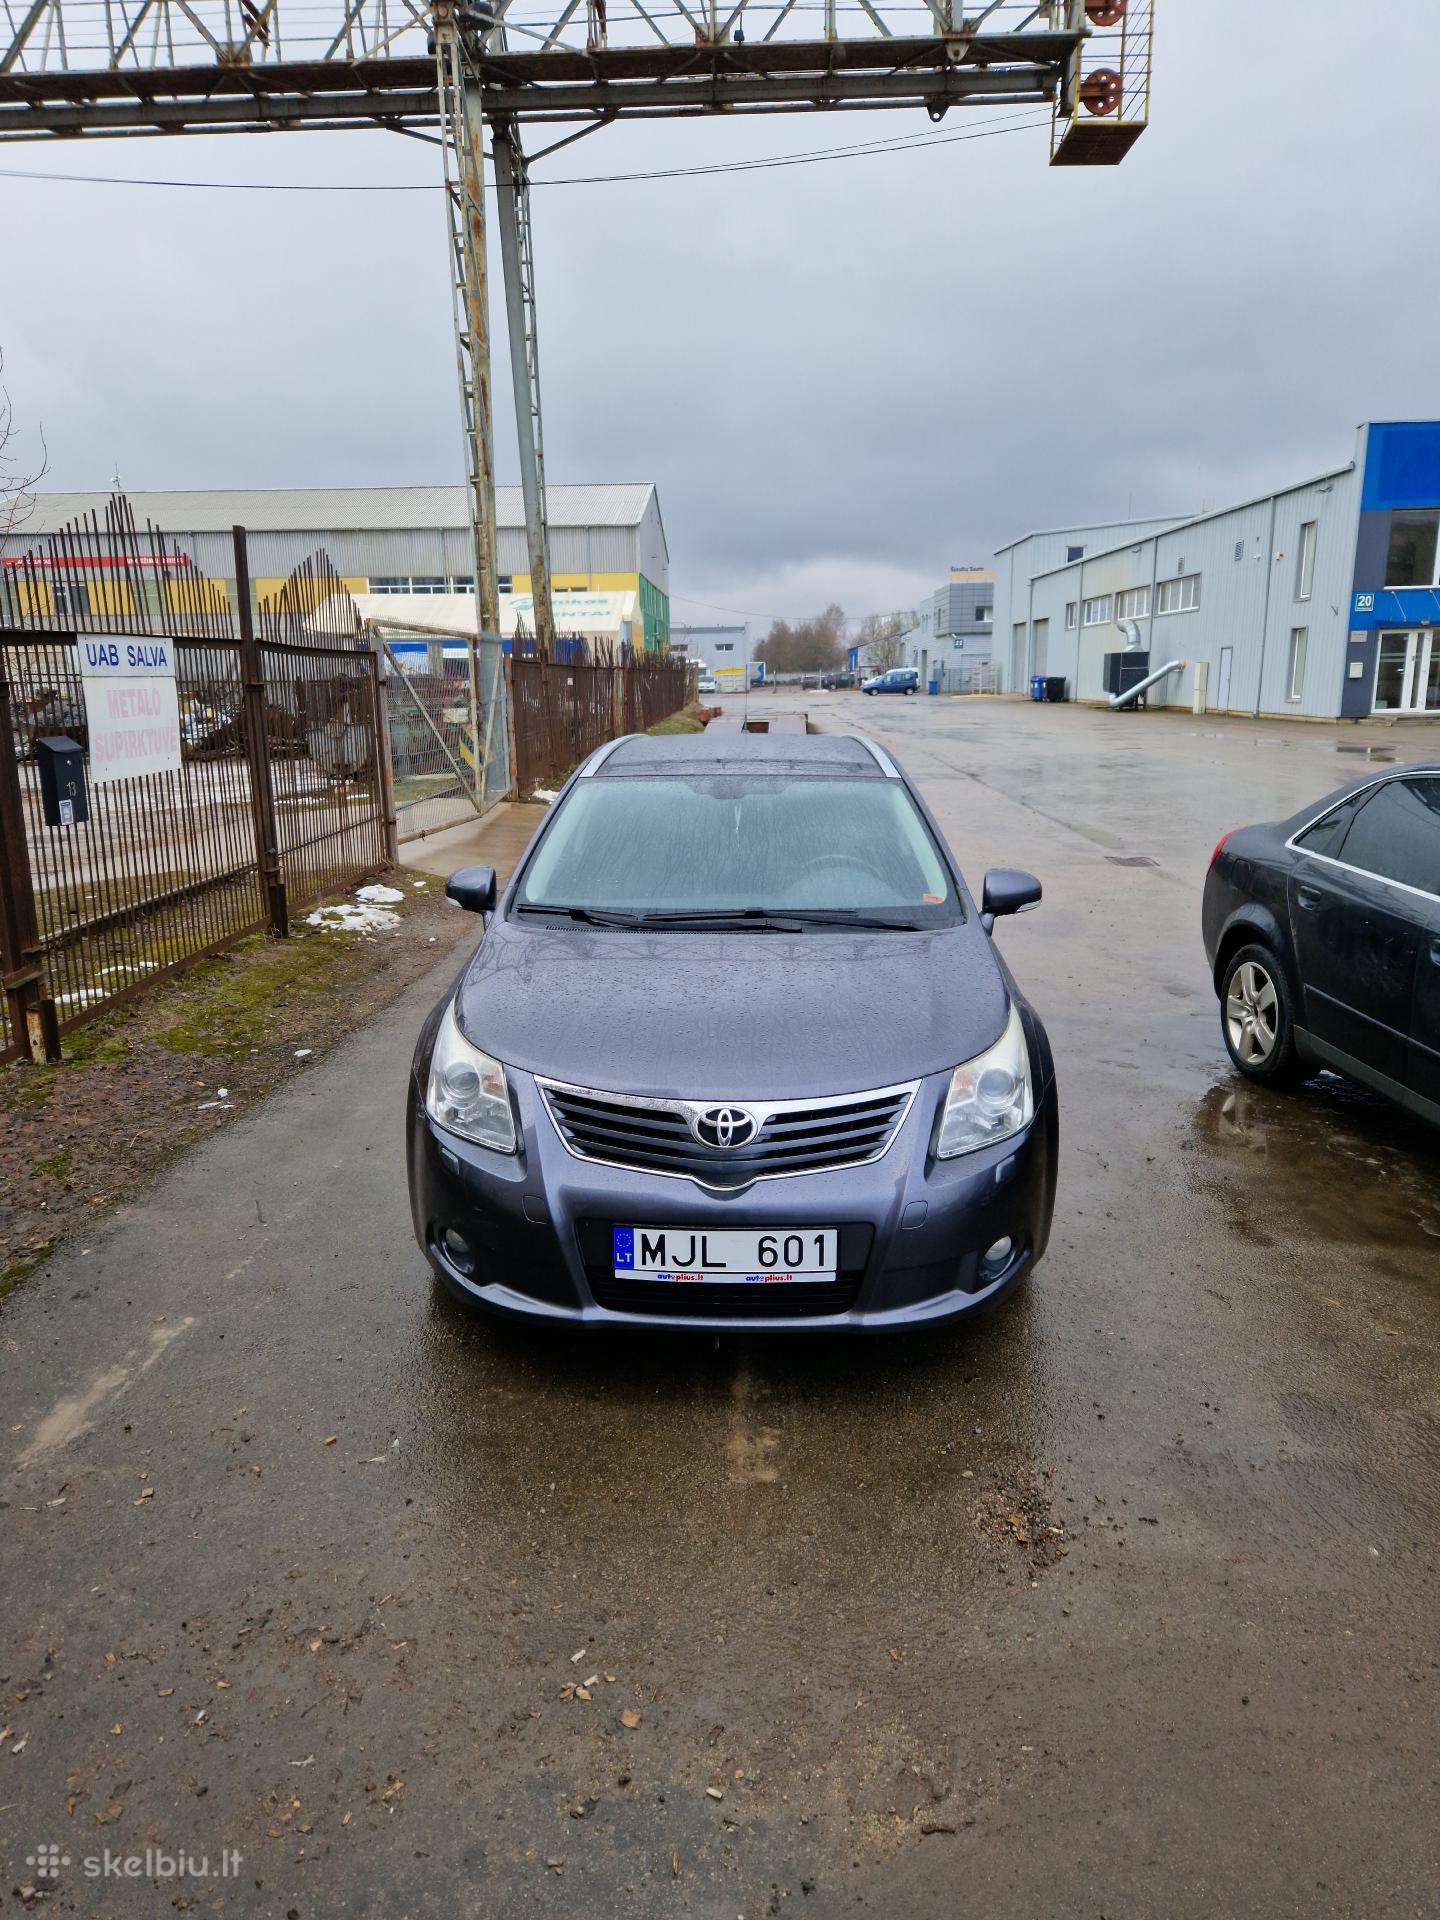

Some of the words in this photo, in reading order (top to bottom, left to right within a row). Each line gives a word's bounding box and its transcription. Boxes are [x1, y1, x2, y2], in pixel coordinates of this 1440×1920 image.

[1358, 595, 1372, 607] 20
[86, 643, 119, 667] UAB
[126, 645, 168, 667] SALVA
[107, 687, 160, 719] METALO
[616, 1252, 632, 1263] LT
[641, 1233, 727, 1268] MJL
[758, 1234, 825, 1268] 601
